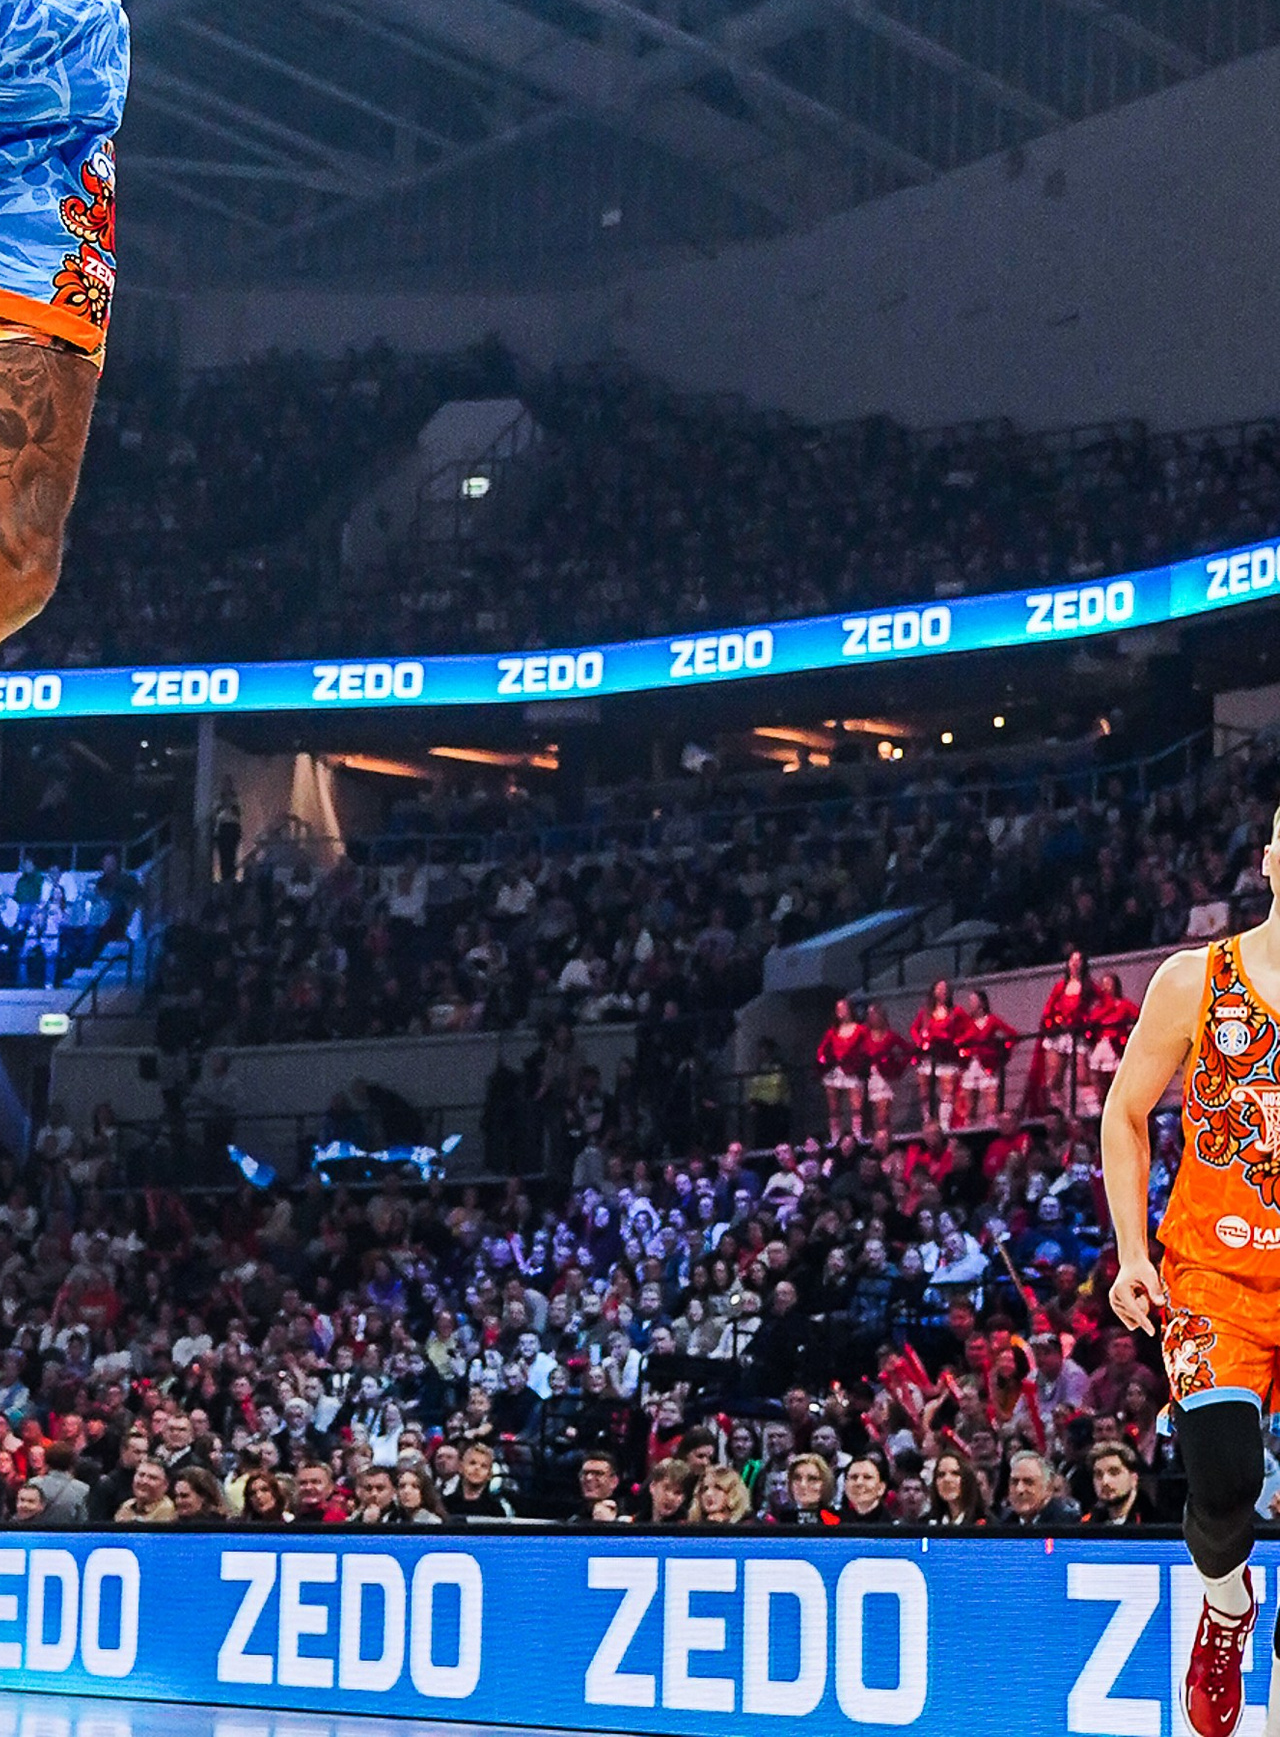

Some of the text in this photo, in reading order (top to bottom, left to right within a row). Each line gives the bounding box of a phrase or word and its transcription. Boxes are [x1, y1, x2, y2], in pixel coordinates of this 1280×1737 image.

[131, 668, 240, 707] ZEDO
[312, 662, 424, 701] ZEDO
[497, 651, 604, 694] ZEDO
[670, 629, 773, 678] ZEDO
[842, 606, 951, 656] ZEDO
[1025, 580, 1135, 634] ZEDO
[1206, 545, 1280, 601] ZED
[217, 1551, 483, 1699] ZEDO
[584, 1556, 929, 1726] ZEDO
